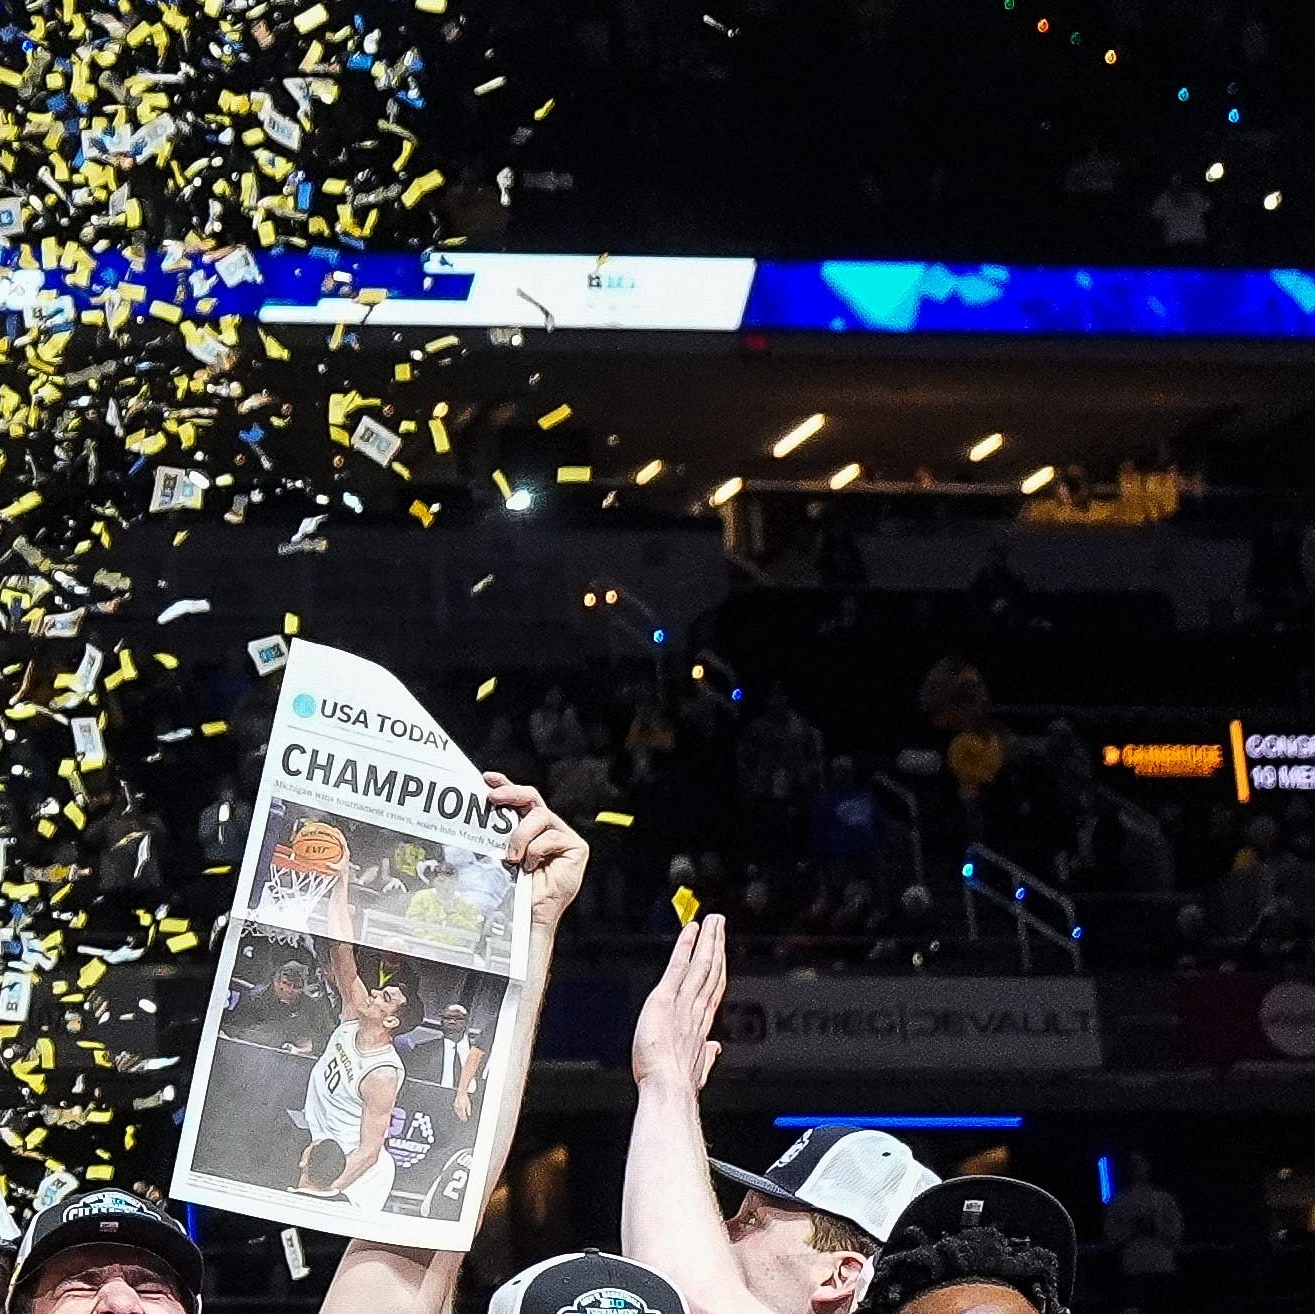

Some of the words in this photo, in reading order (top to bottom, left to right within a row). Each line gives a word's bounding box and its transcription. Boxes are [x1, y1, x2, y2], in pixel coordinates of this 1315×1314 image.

[320, 699, 369, 729] USA
[377, 714, 449, 751] TODAY
[281, 744, 513, 834] CHAMPIONS
